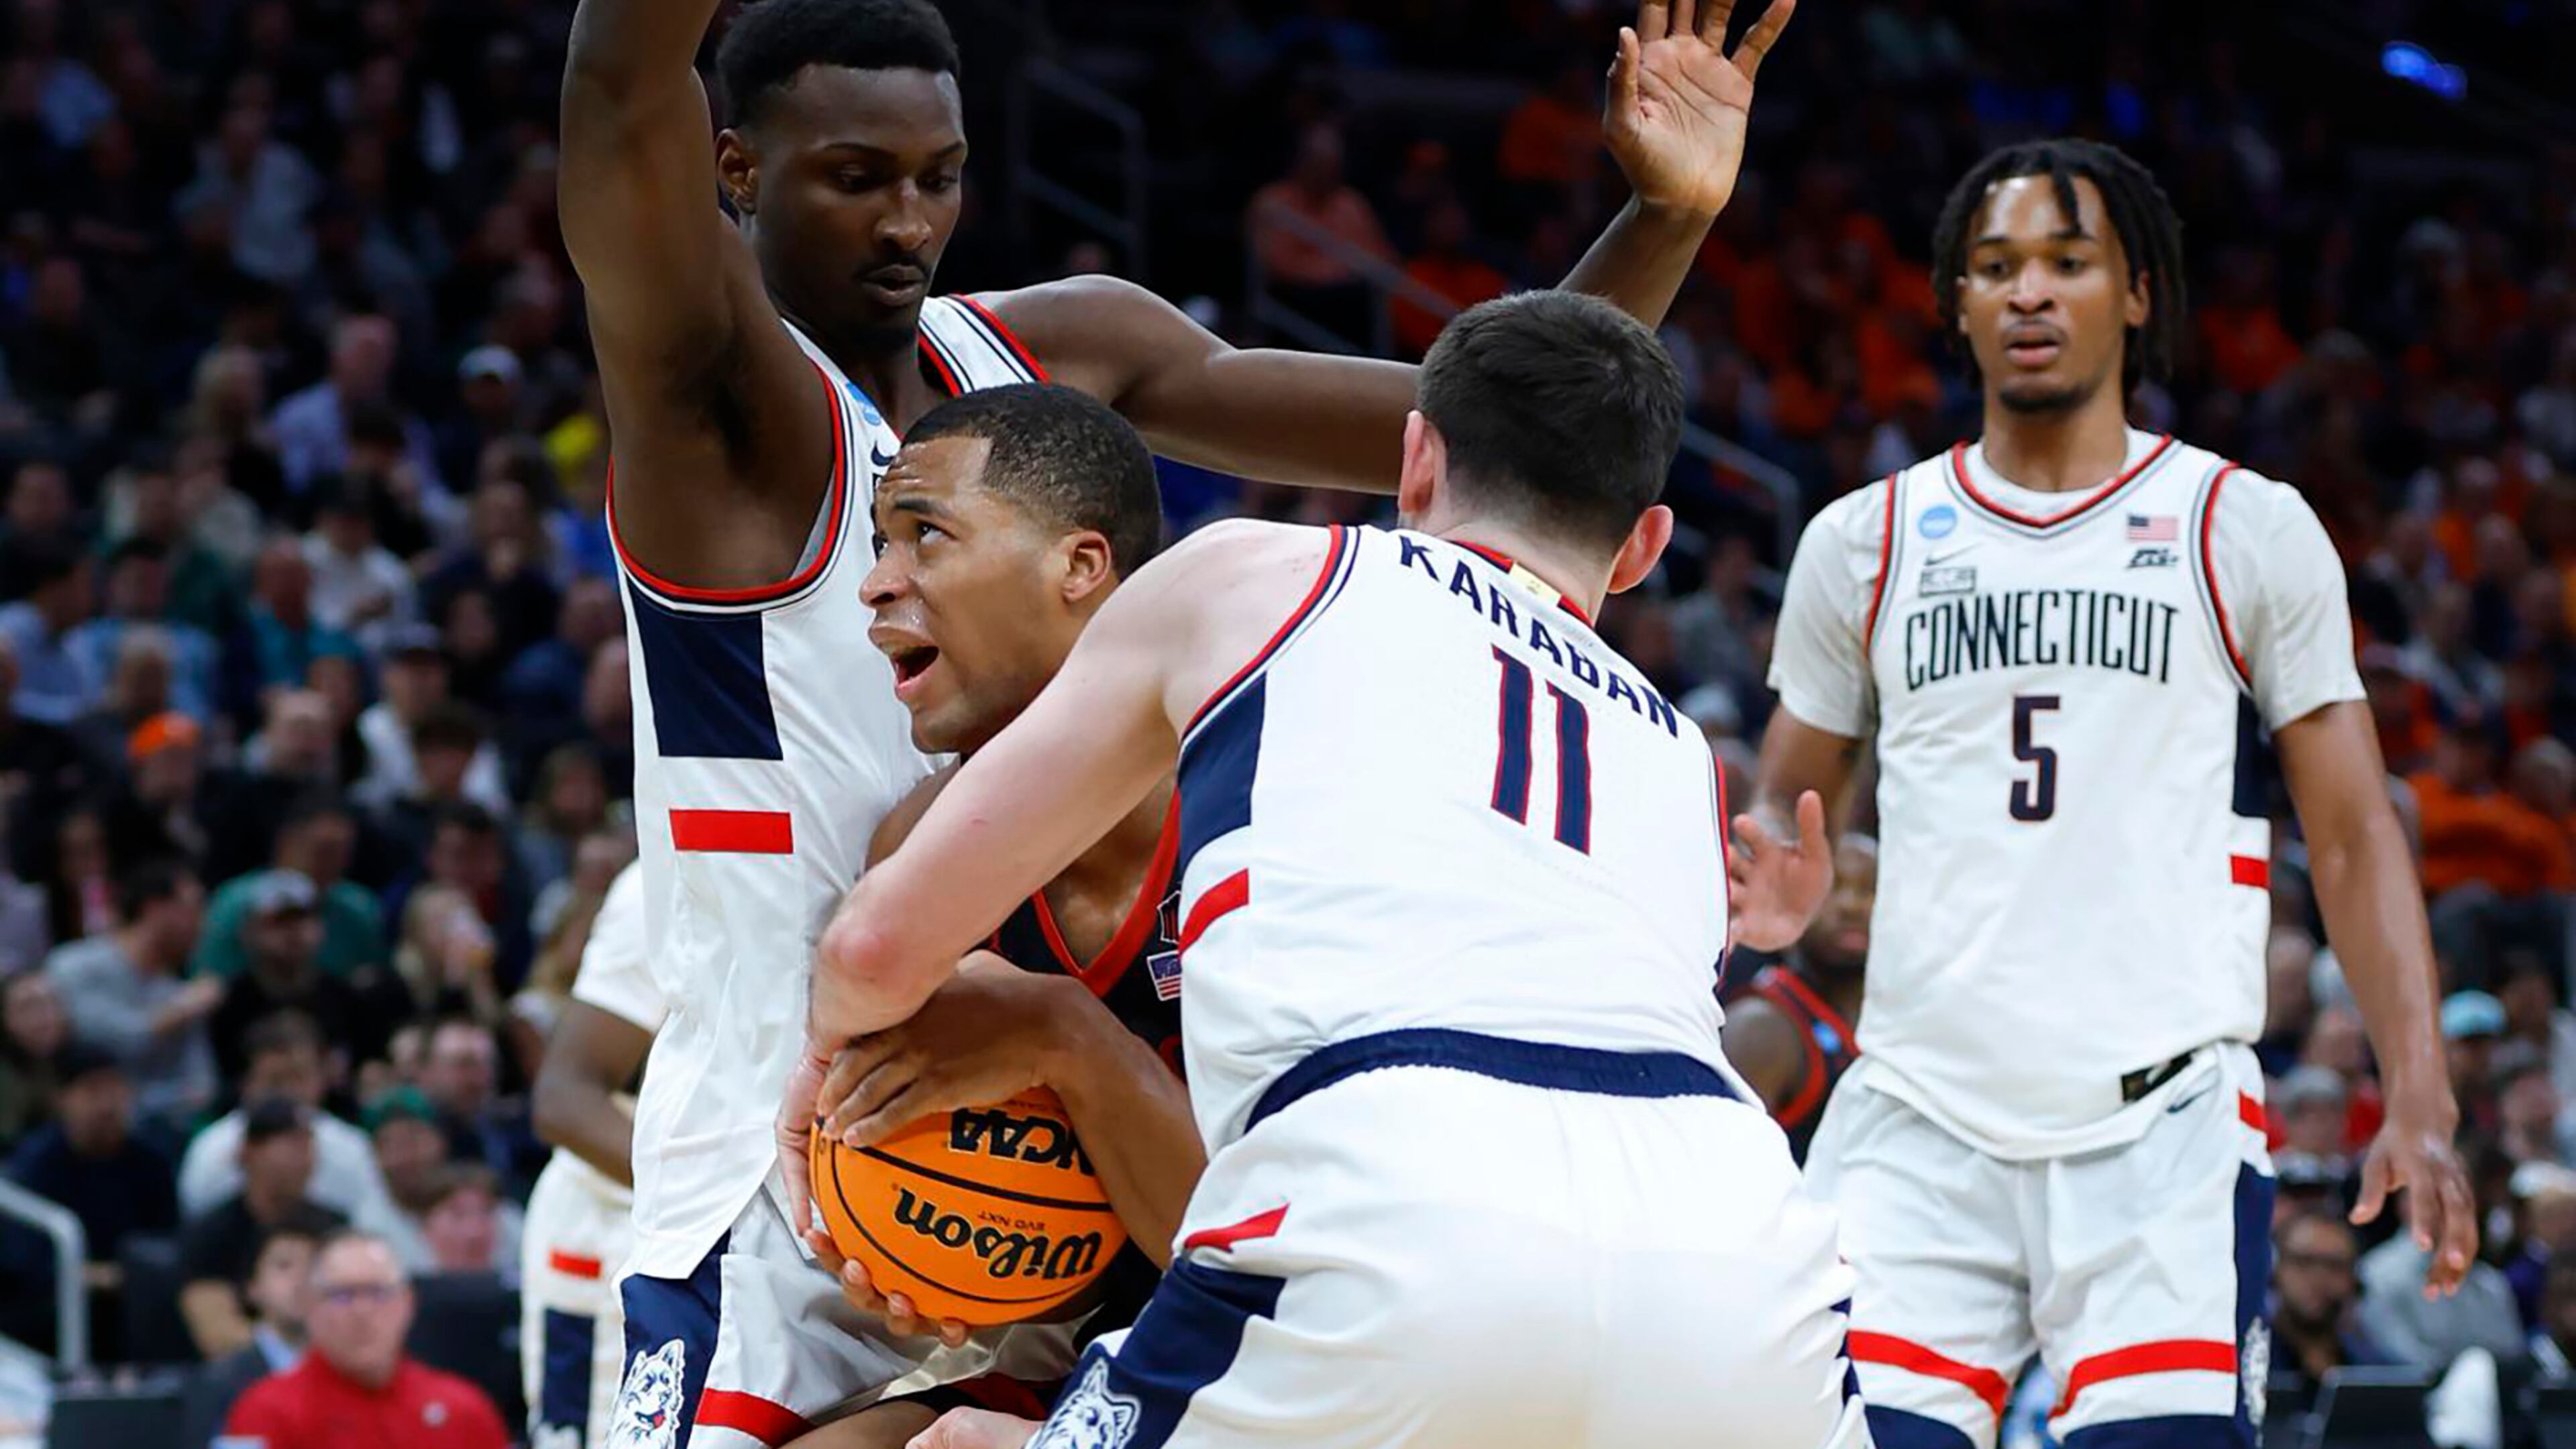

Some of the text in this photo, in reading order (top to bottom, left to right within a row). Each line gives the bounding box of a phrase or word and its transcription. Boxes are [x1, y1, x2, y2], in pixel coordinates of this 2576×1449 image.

[1399, 535, 1678, 739] KARABAN
[1907, 588, 2180, 692] CONNECTICUT
[1490, 642, 1592, 857] 11
[2009, 694, 2061, 822] 5
[893, 1186, 1102, 1279] Wilson
